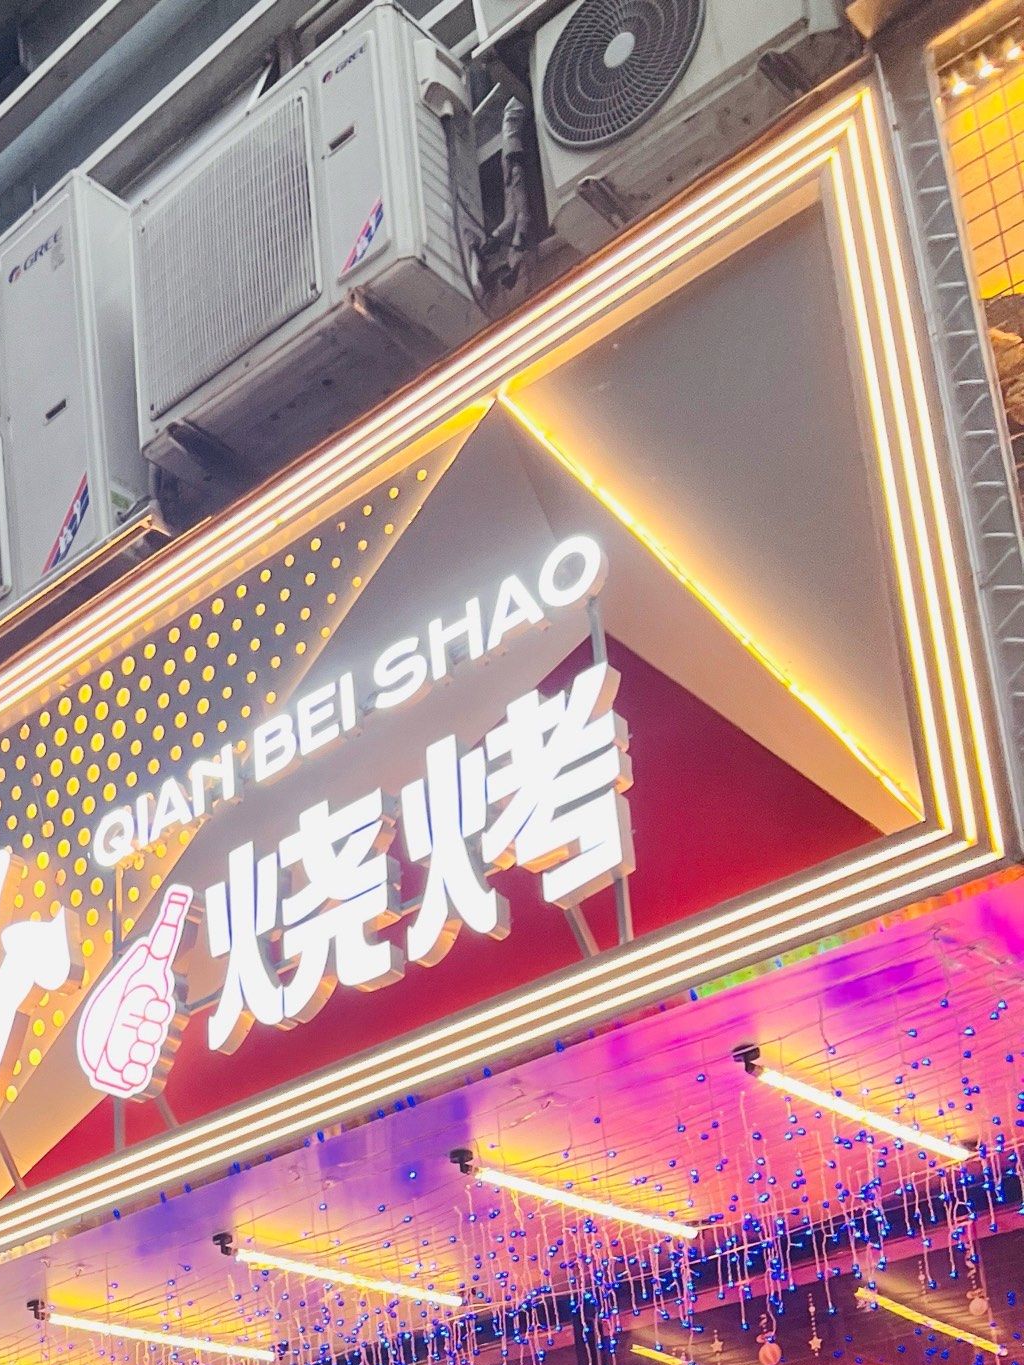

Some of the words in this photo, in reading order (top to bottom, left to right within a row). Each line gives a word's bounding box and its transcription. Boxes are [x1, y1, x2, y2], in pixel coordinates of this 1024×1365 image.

[92, 744, 236, 868] QIAN
[253, 672, 356, 783] BEI
[374, 535, 603, 710] SHAO
[206, 662, 626, 1051] 烧烤
